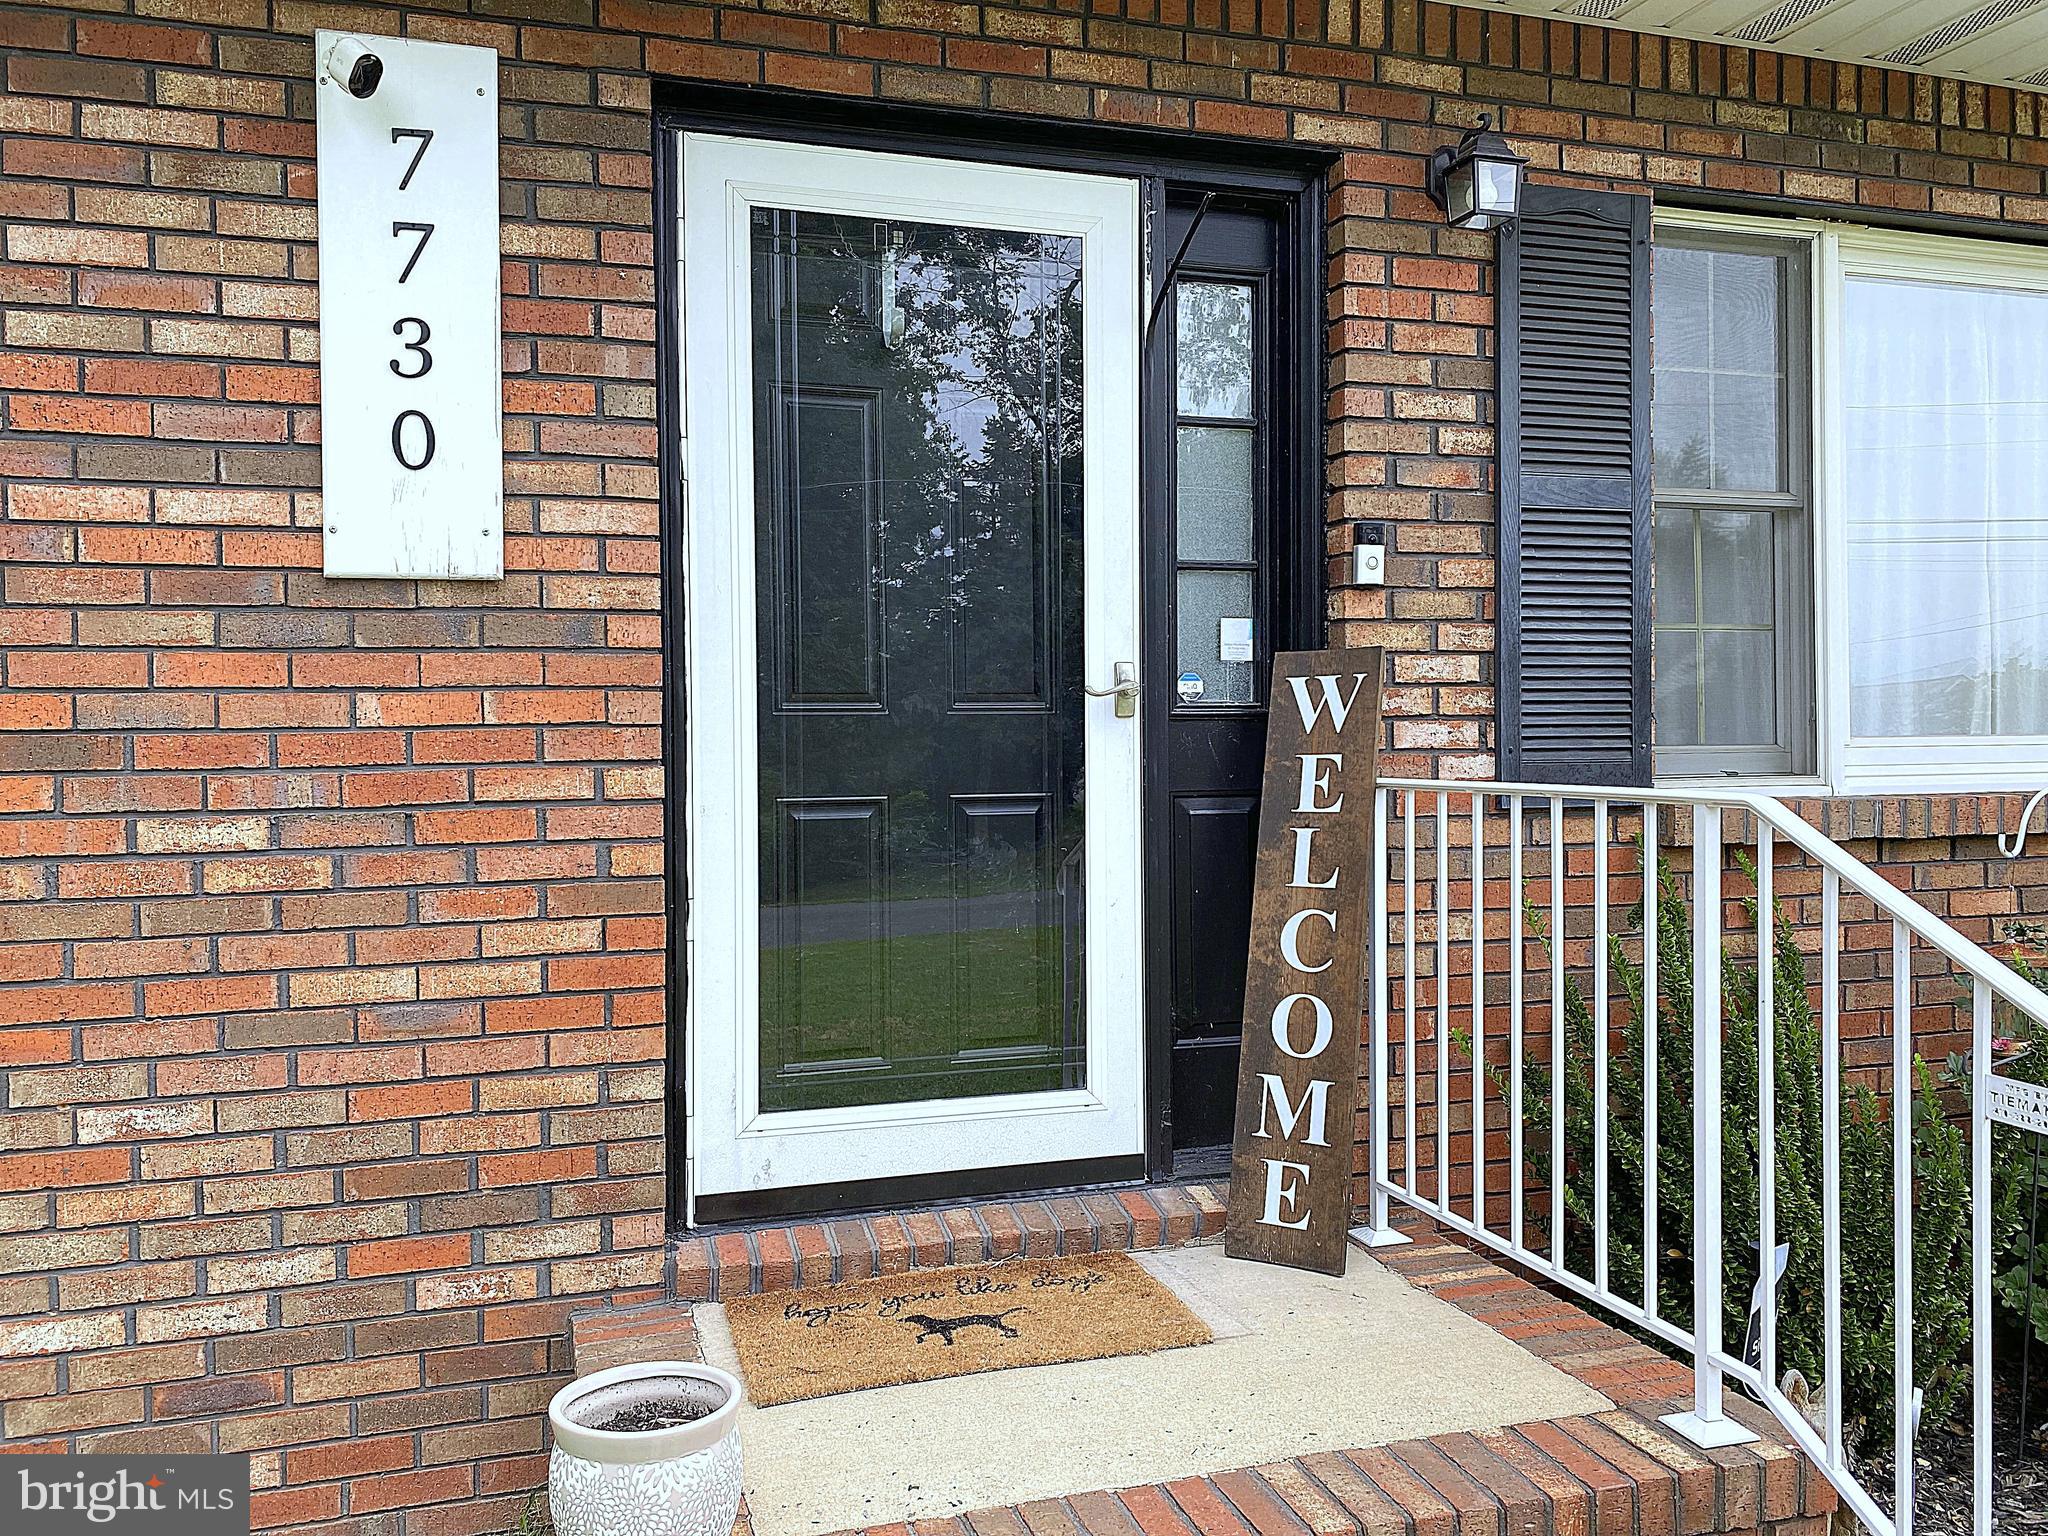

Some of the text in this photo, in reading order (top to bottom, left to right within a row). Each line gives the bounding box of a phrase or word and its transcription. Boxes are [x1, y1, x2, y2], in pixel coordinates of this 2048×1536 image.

[390, 127, 435, 471] 7730
[1251, 673, 1367, 1231] WELCOME
[877, 1291, 946, 1317] you
[955, 1274, 1018, 1296] like
